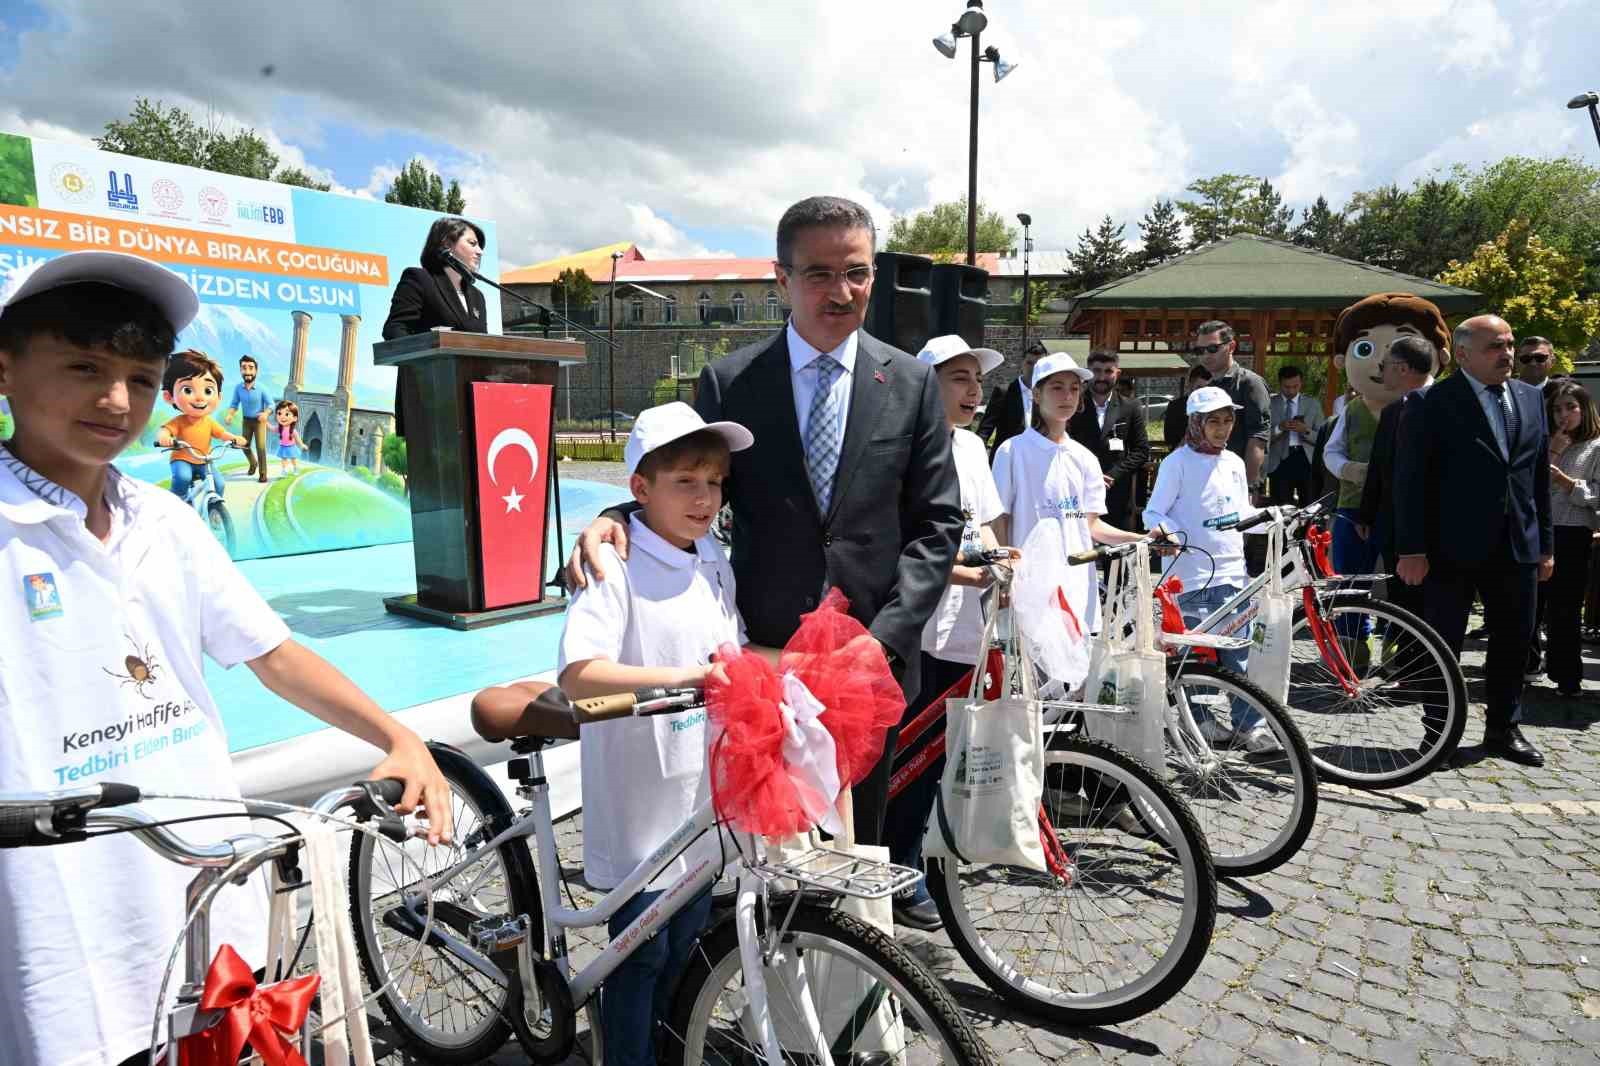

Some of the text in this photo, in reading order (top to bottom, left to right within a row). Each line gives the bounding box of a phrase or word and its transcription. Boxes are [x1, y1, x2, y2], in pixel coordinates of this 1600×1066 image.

[68, 221, 112, 245] BİR
[118, 228, 202, 256] DÜNYA
[207, 240, 272, 263] BIRAK
[277, 249, 382, 277] ÇOCUĞUNA
[277, 283, 354, 307] OLSUN
[63, 715, 133, 753] Keneyi
[137, 702, 181, 729] Hafife
[54, 745, 129, 785] Tedbiri
